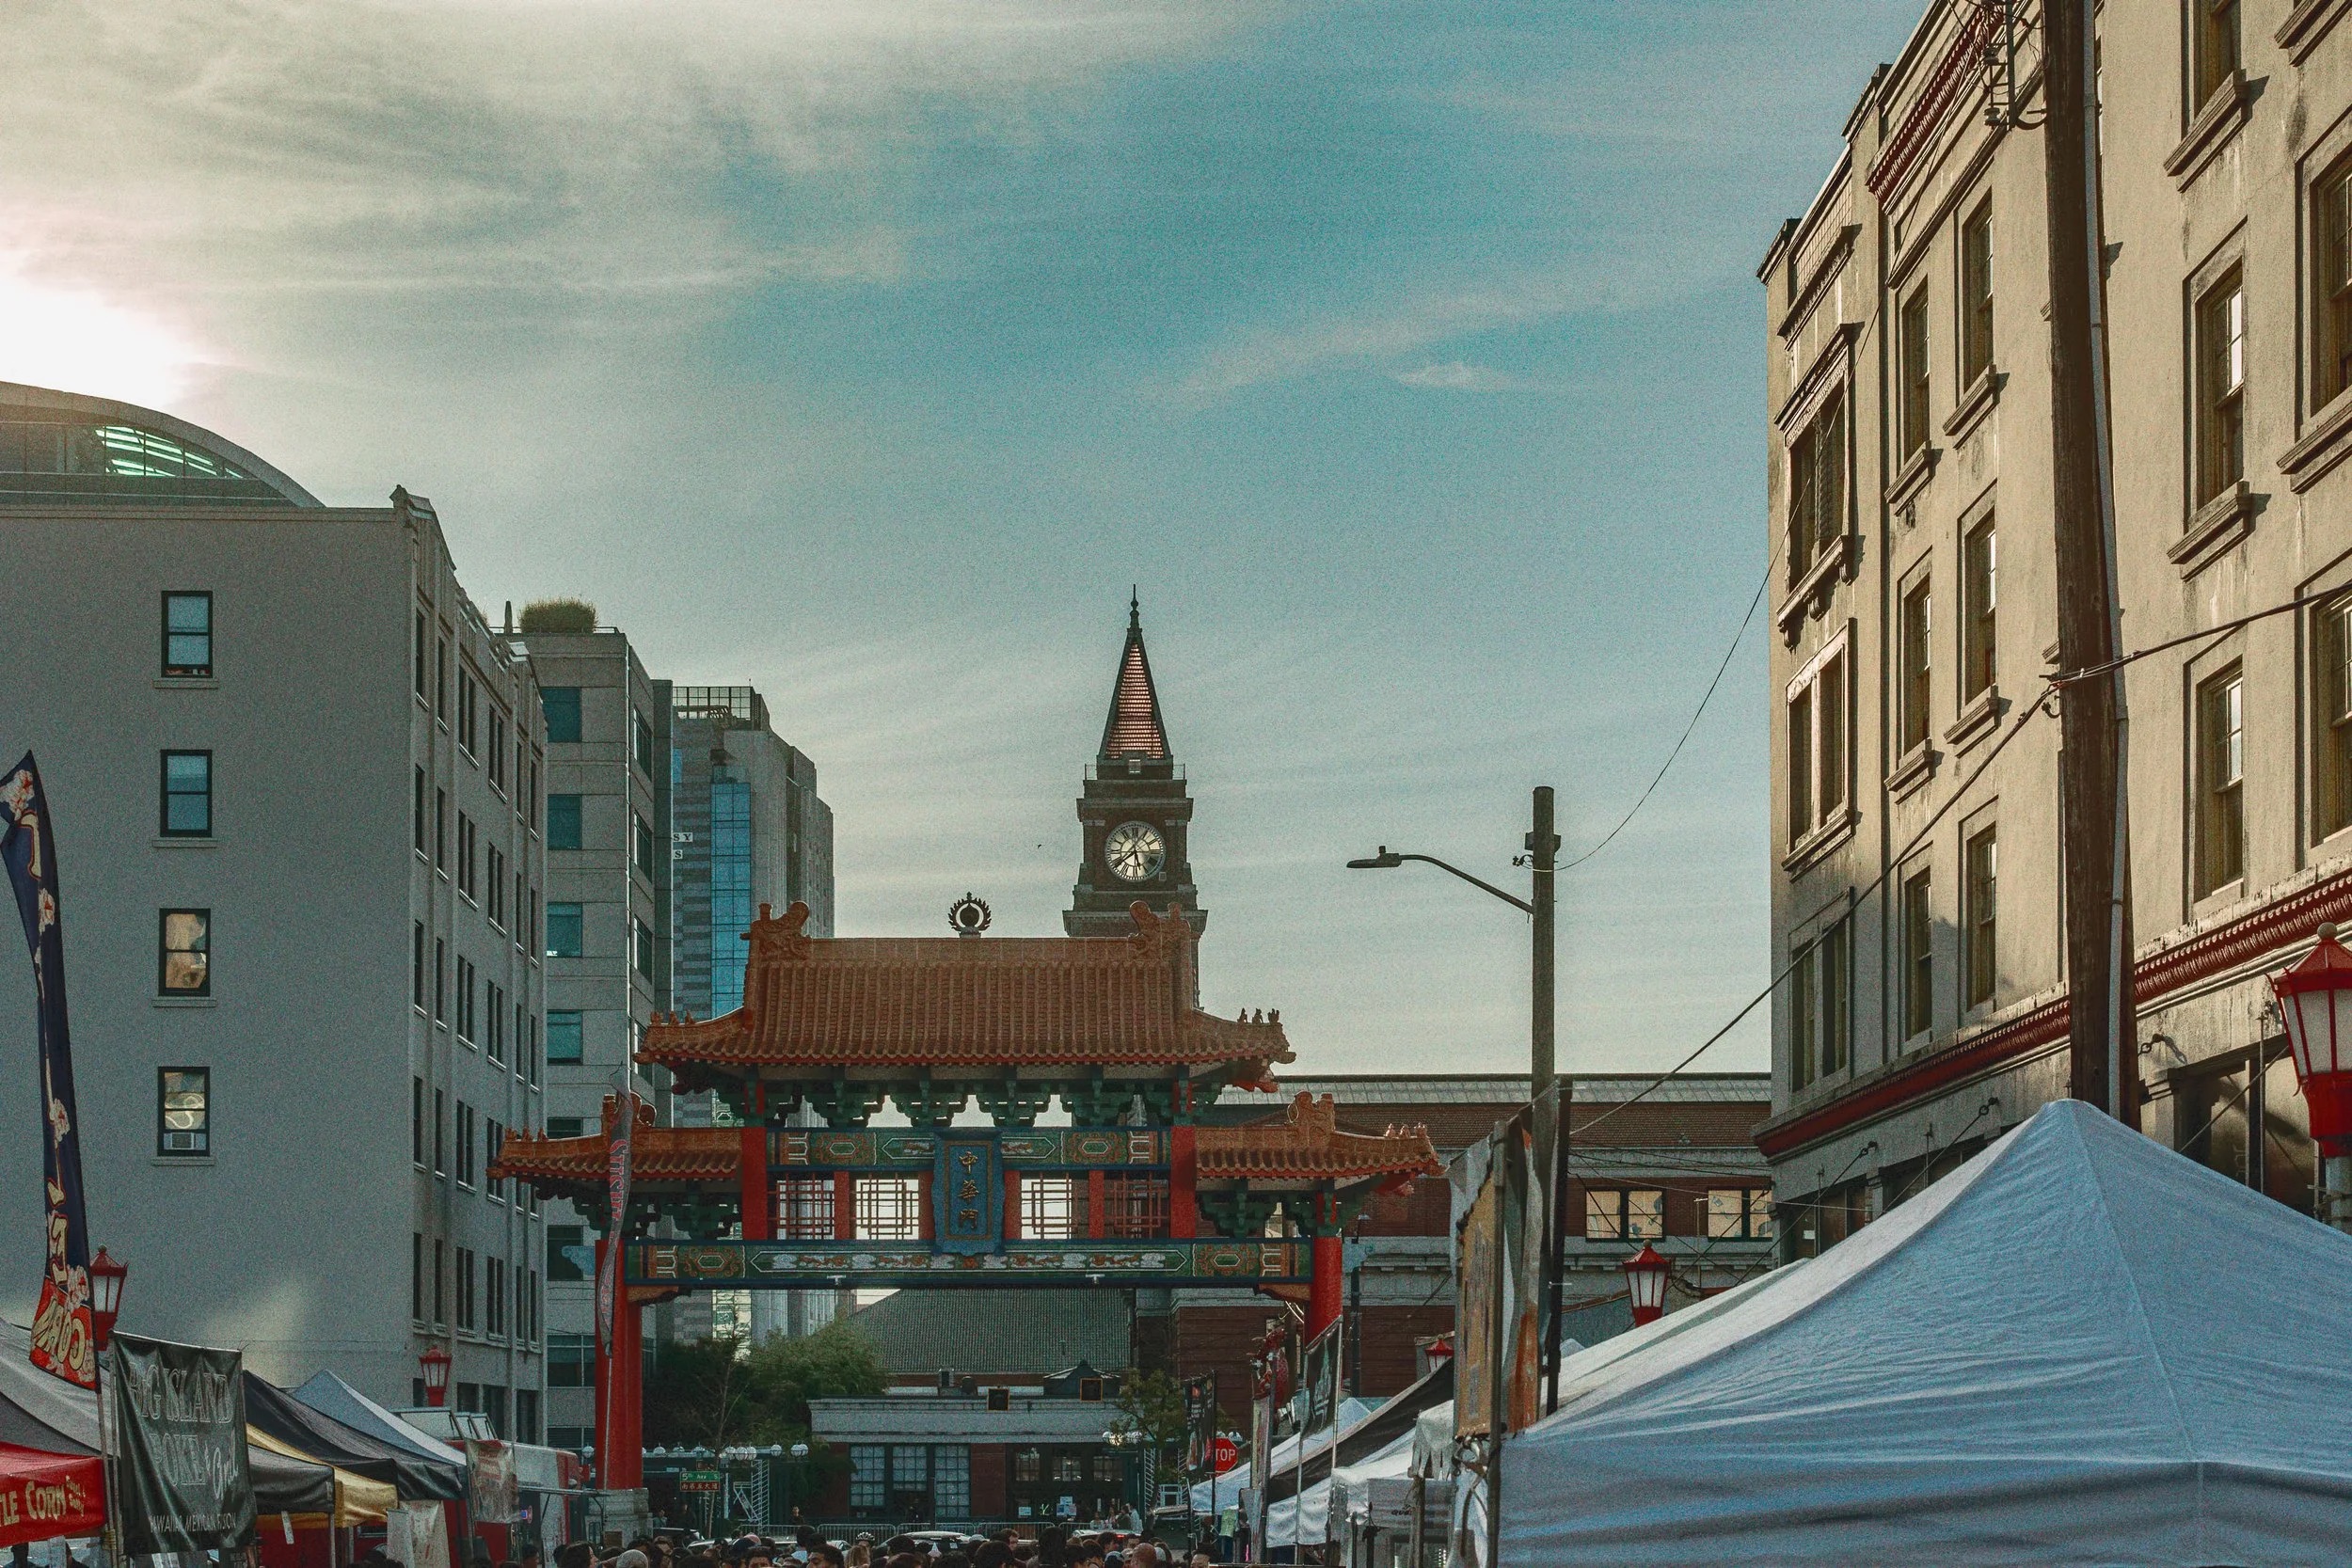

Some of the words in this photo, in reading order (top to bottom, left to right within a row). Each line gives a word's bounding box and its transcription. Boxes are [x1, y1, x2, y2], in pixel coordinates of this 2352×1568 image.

[958, 1150, 978, 1228] 中華門
[163, 1368, 233, 1424] ISLAND
[1216, 1448, 1236, 1461] TOP
